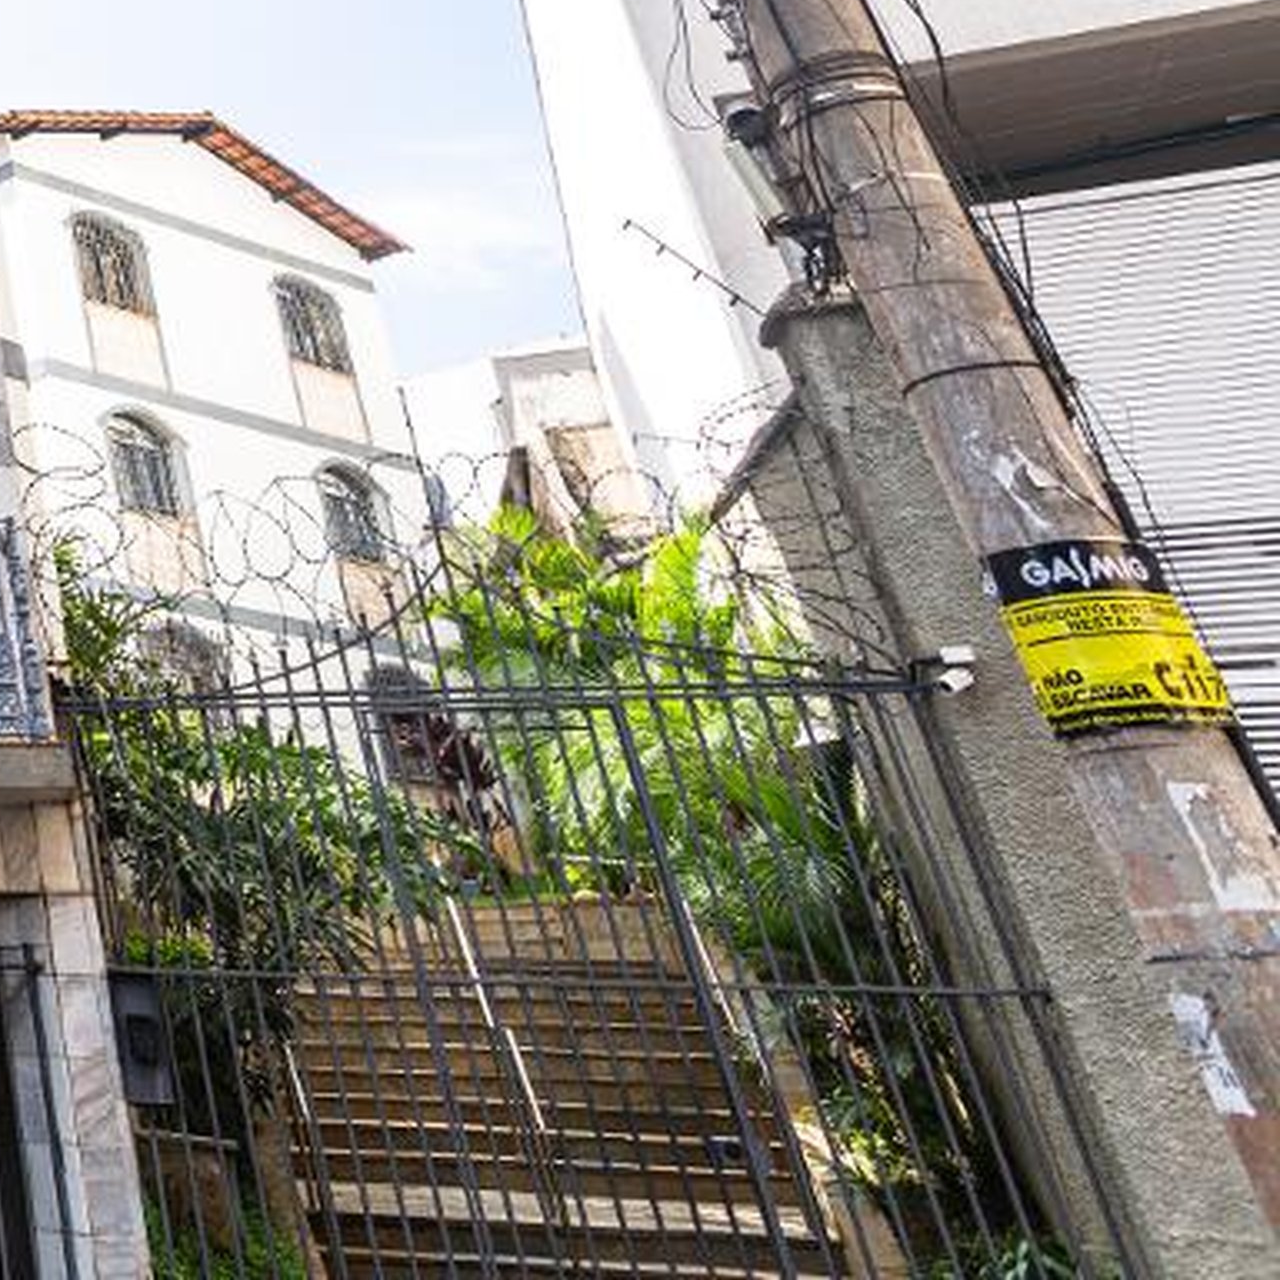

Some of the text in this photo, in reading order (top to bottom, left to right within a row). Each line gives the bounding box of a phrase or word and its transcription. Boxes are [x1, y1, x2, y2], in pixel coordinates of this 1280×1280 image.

[1019, 546, 1150, 589] GASMIG
[1042, 667, 1083, 691] NÃO
[1049, 683, 1153, 710] ESCAVAR
